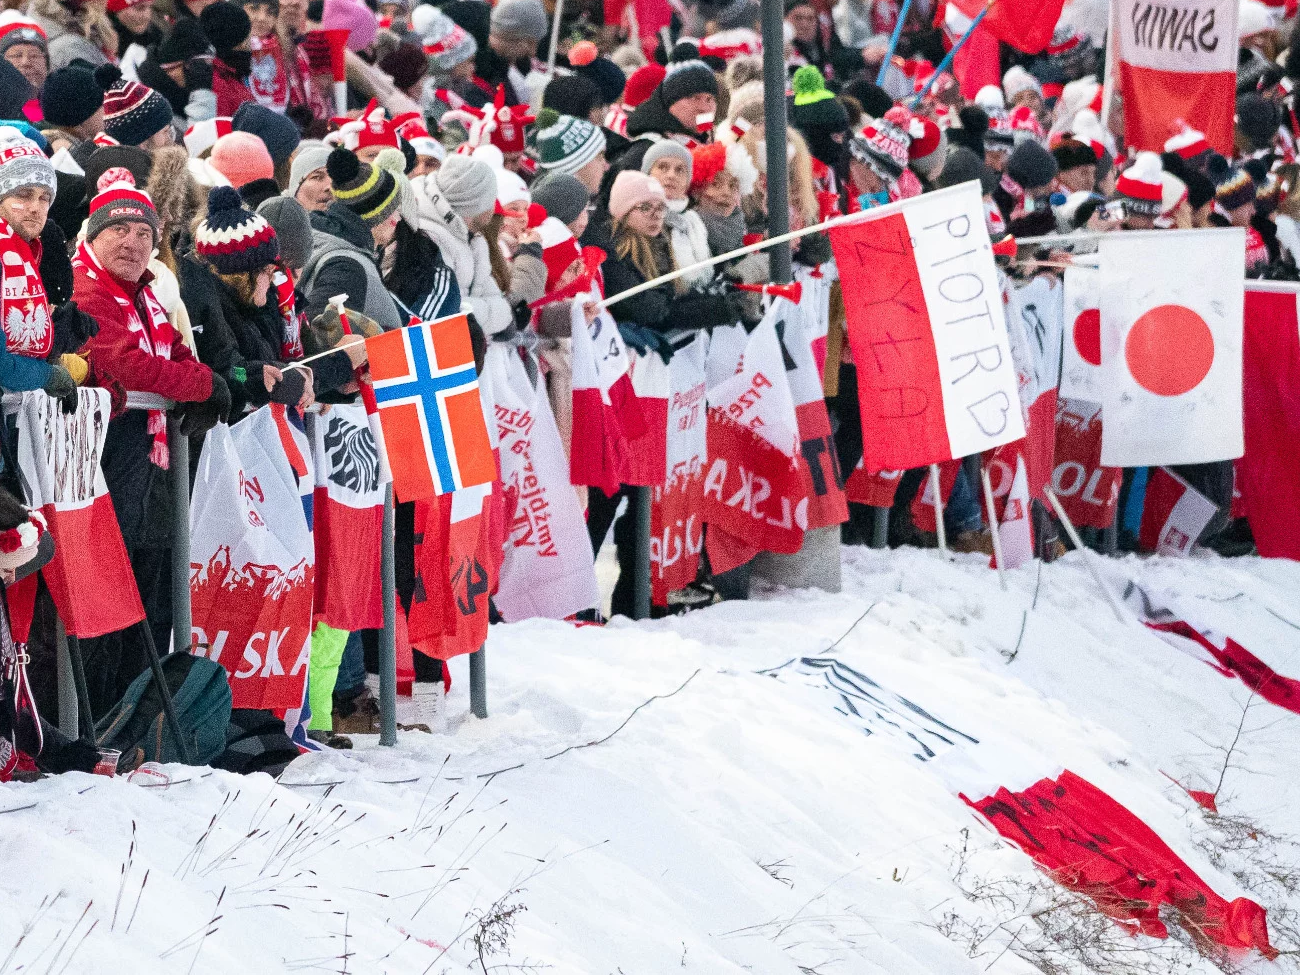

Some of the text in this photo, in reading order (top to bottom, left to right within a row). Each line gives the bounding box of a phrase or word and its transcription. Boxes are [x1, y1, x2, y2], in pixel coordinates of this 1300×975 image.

[110, 207, 144, 217] POLSKA
[923, 213, 1003, 386] PIOTR
[190, 626, 312, 678] OLSKA
